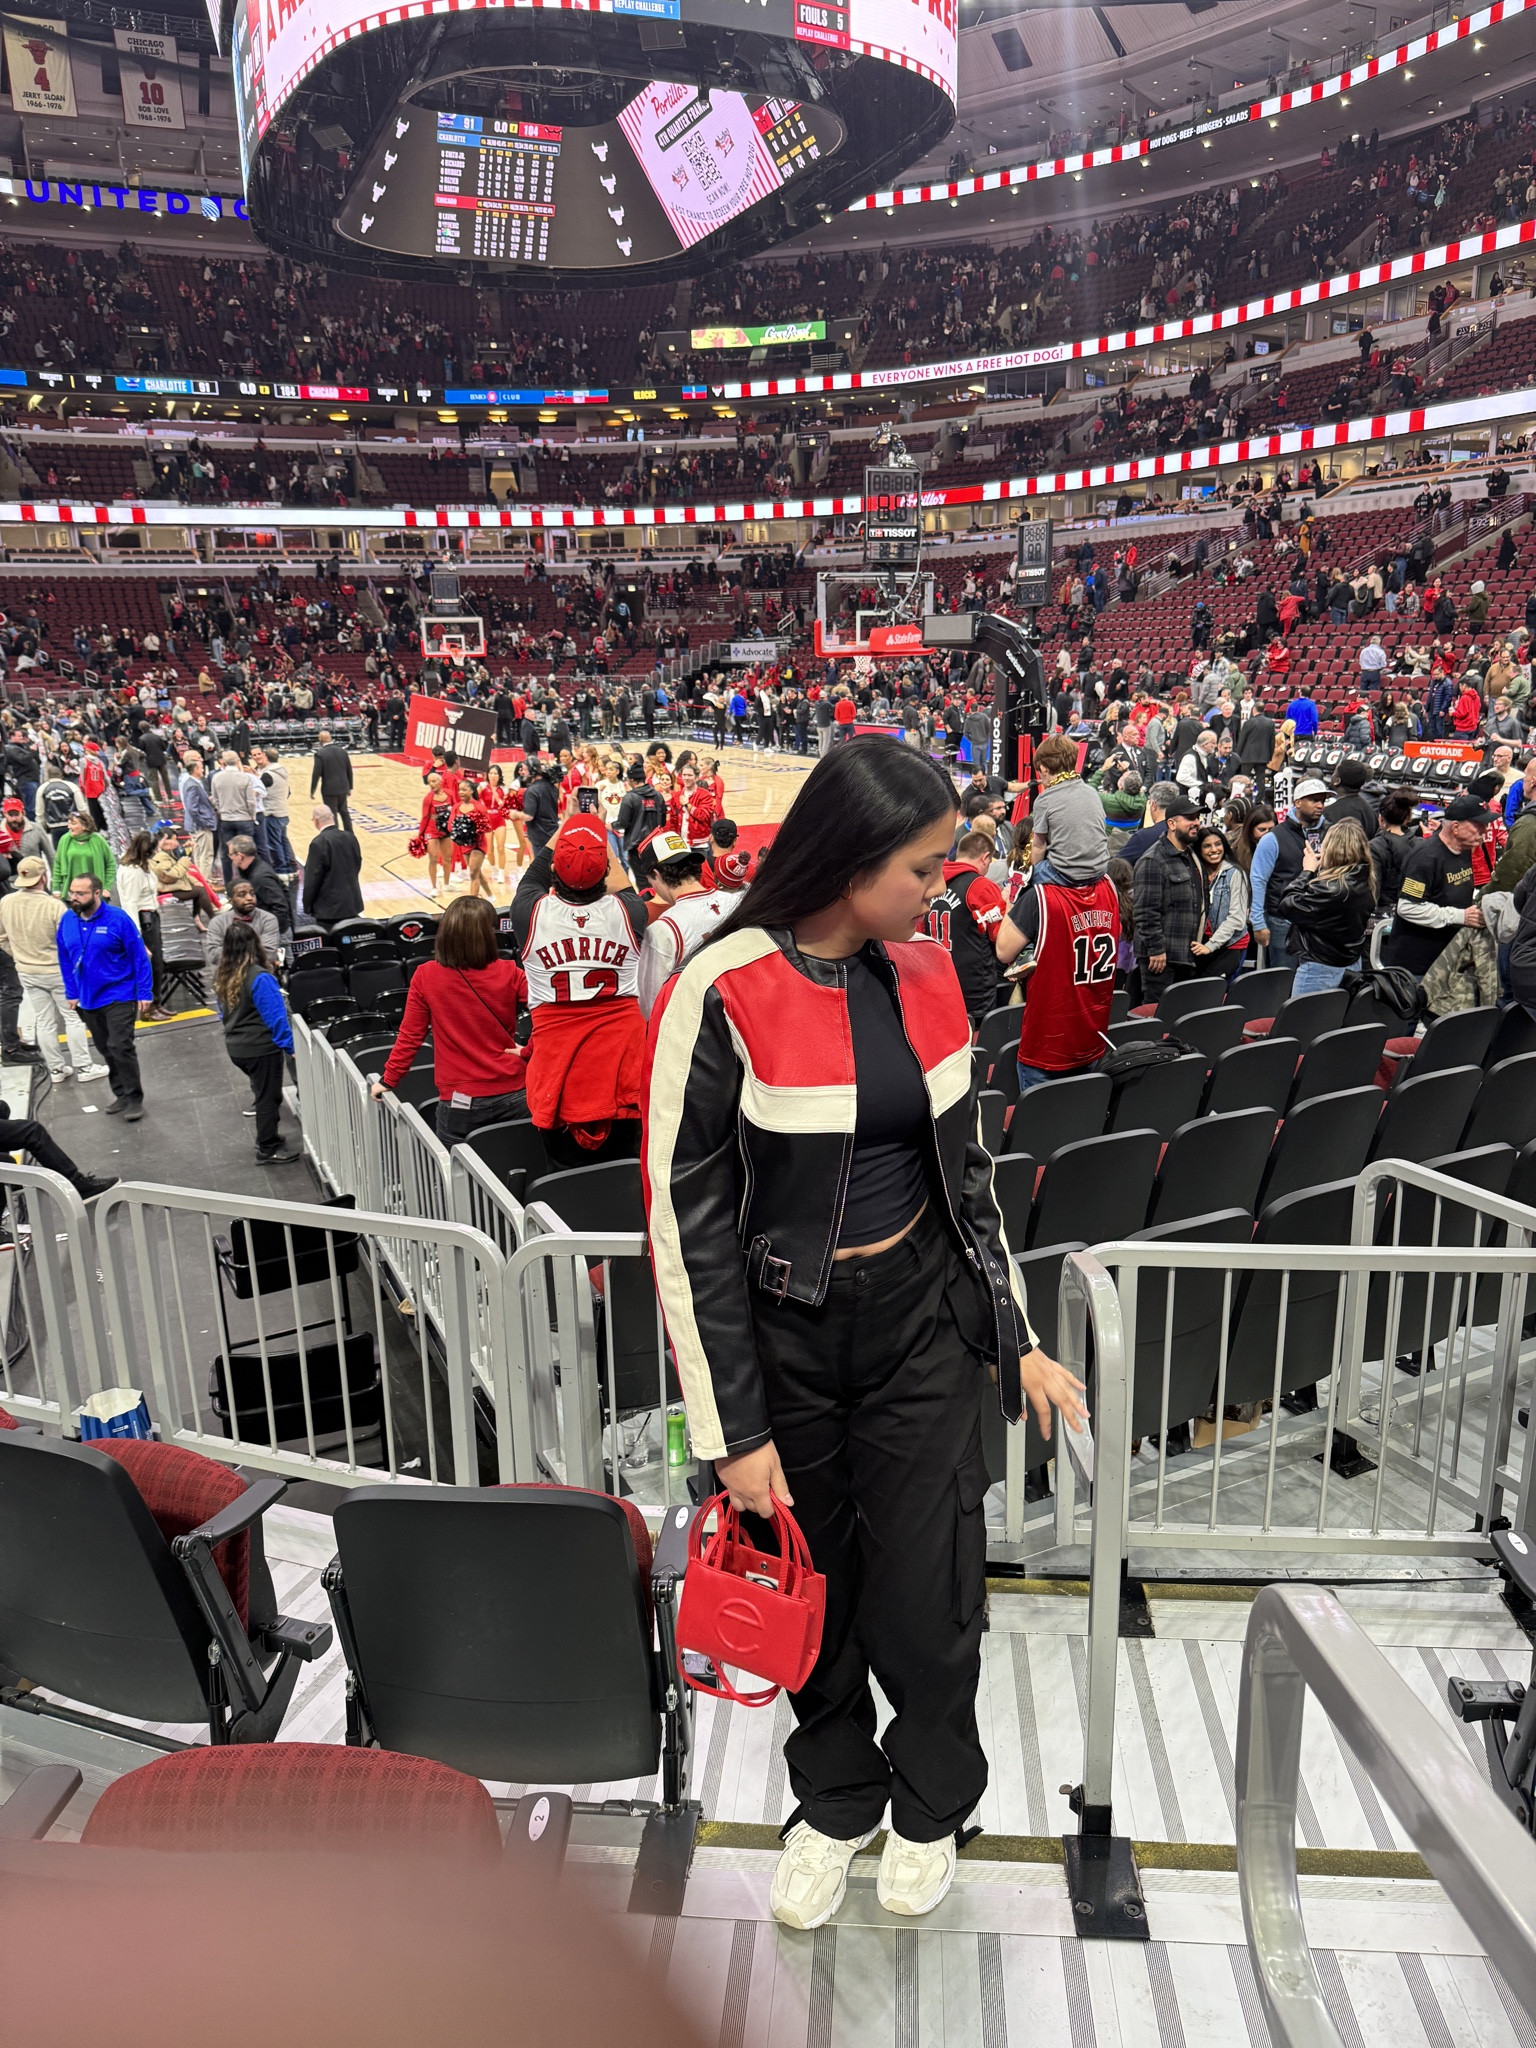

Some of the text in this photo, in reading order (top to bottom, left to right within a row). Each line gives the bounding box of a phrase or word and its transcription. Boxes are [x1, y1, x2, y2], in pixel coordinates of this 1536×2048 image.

[800, 5, 844, 31] FOULS 5
[127, 37, 165, 48] CHICAGO
[796, 26, 814, 36] REPLAY
[814, 30, 839, 44] CHALLENGE
[34, 67, 51, 92] 4
[22, 91, 66, 102] JERRY SLOAN
[139, 81, 164, 106] 10
[650, 83, 688, 119] Portillo's
[138, 105, 169, 115] BOB LOVE
[463, 117, 475, 130] 91
[494, 120, 508, 134] 0.0
[524, 125, 539, 137] 104
[657, 130, 671, 147] 4TH
[666, 113, 692, 140] QUARTER
[1150, 110, 1249, 149] HOT DOGS BEEF BURGERS SALADS
[25, 179, 191, 215] UNITED
[671, 202, 686, 215] LAST
[686, 209, 707, 221] CHANCE
[707, 211, 714, 220] TO
[713, 203, 731, 220] REDEEM
[731, 193, 741, 208] YOUR
[738, 178, 749, 196] FREE
[744, 163, 753, 180] HOT
[706, 182, 732, 205] SCAN NOW!
[872, 348, 1064, 384] EVERYONE WINS A FREE HOT DOG!
[145, 379, 187, 392] CHARLOTTE
[198, 382, 211, 393] 91
[280, 385, 296, 397] 104
[308, 386, 340, 399] CHICAGO
[633, 390, 657, 400] BLOCKS
[883, 528, 917, 538] TISSOT
[1026, 568, 1046, 577] TISSOT
[741, 648, 773, 657] Advocate
[415, 721, 486, 761] BULLS WIN!
[991, 717, 1003, 777] coinba
[1419, 746, 1463, 757] GATORADE
[1446, 867, 1473, 884] Bourbon
[928, 910, 952, 951] 11
[1070, 910, 1114, 933] HINRICH
[296, 940, 316, 952] USO
[535, 937, 630, 971] HINRICH
[1073, 933, 1117, 986] 12
[550, 969, 619, 1003] 12
